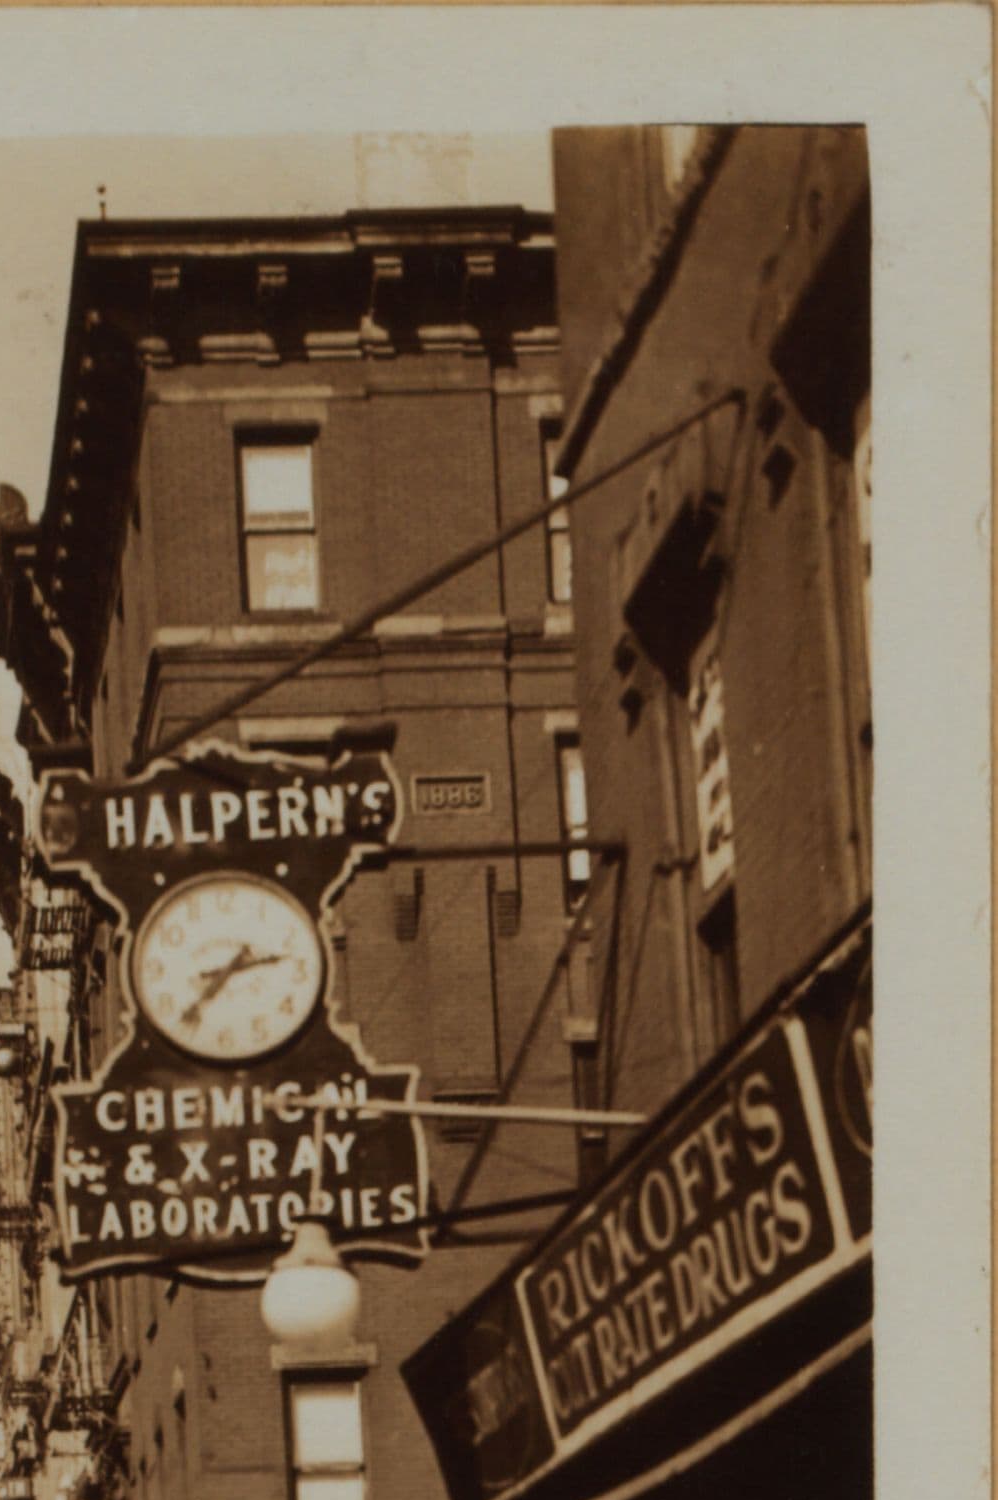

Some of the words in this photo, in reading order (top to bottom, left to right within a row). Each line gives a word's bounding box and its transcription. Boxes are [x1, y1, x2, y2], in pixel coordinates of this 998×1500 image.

[105, 780, 391, 849] HALPERN'S
[95, 1078, 384, 1133] CHEMICAL
[124, 1143, 157, 1185] &
[178, 1132, 357, 1183] X-RAY
[593, 1271, 677, 1390] RATE
[669, 1162, 812, 1332] DRUGS
